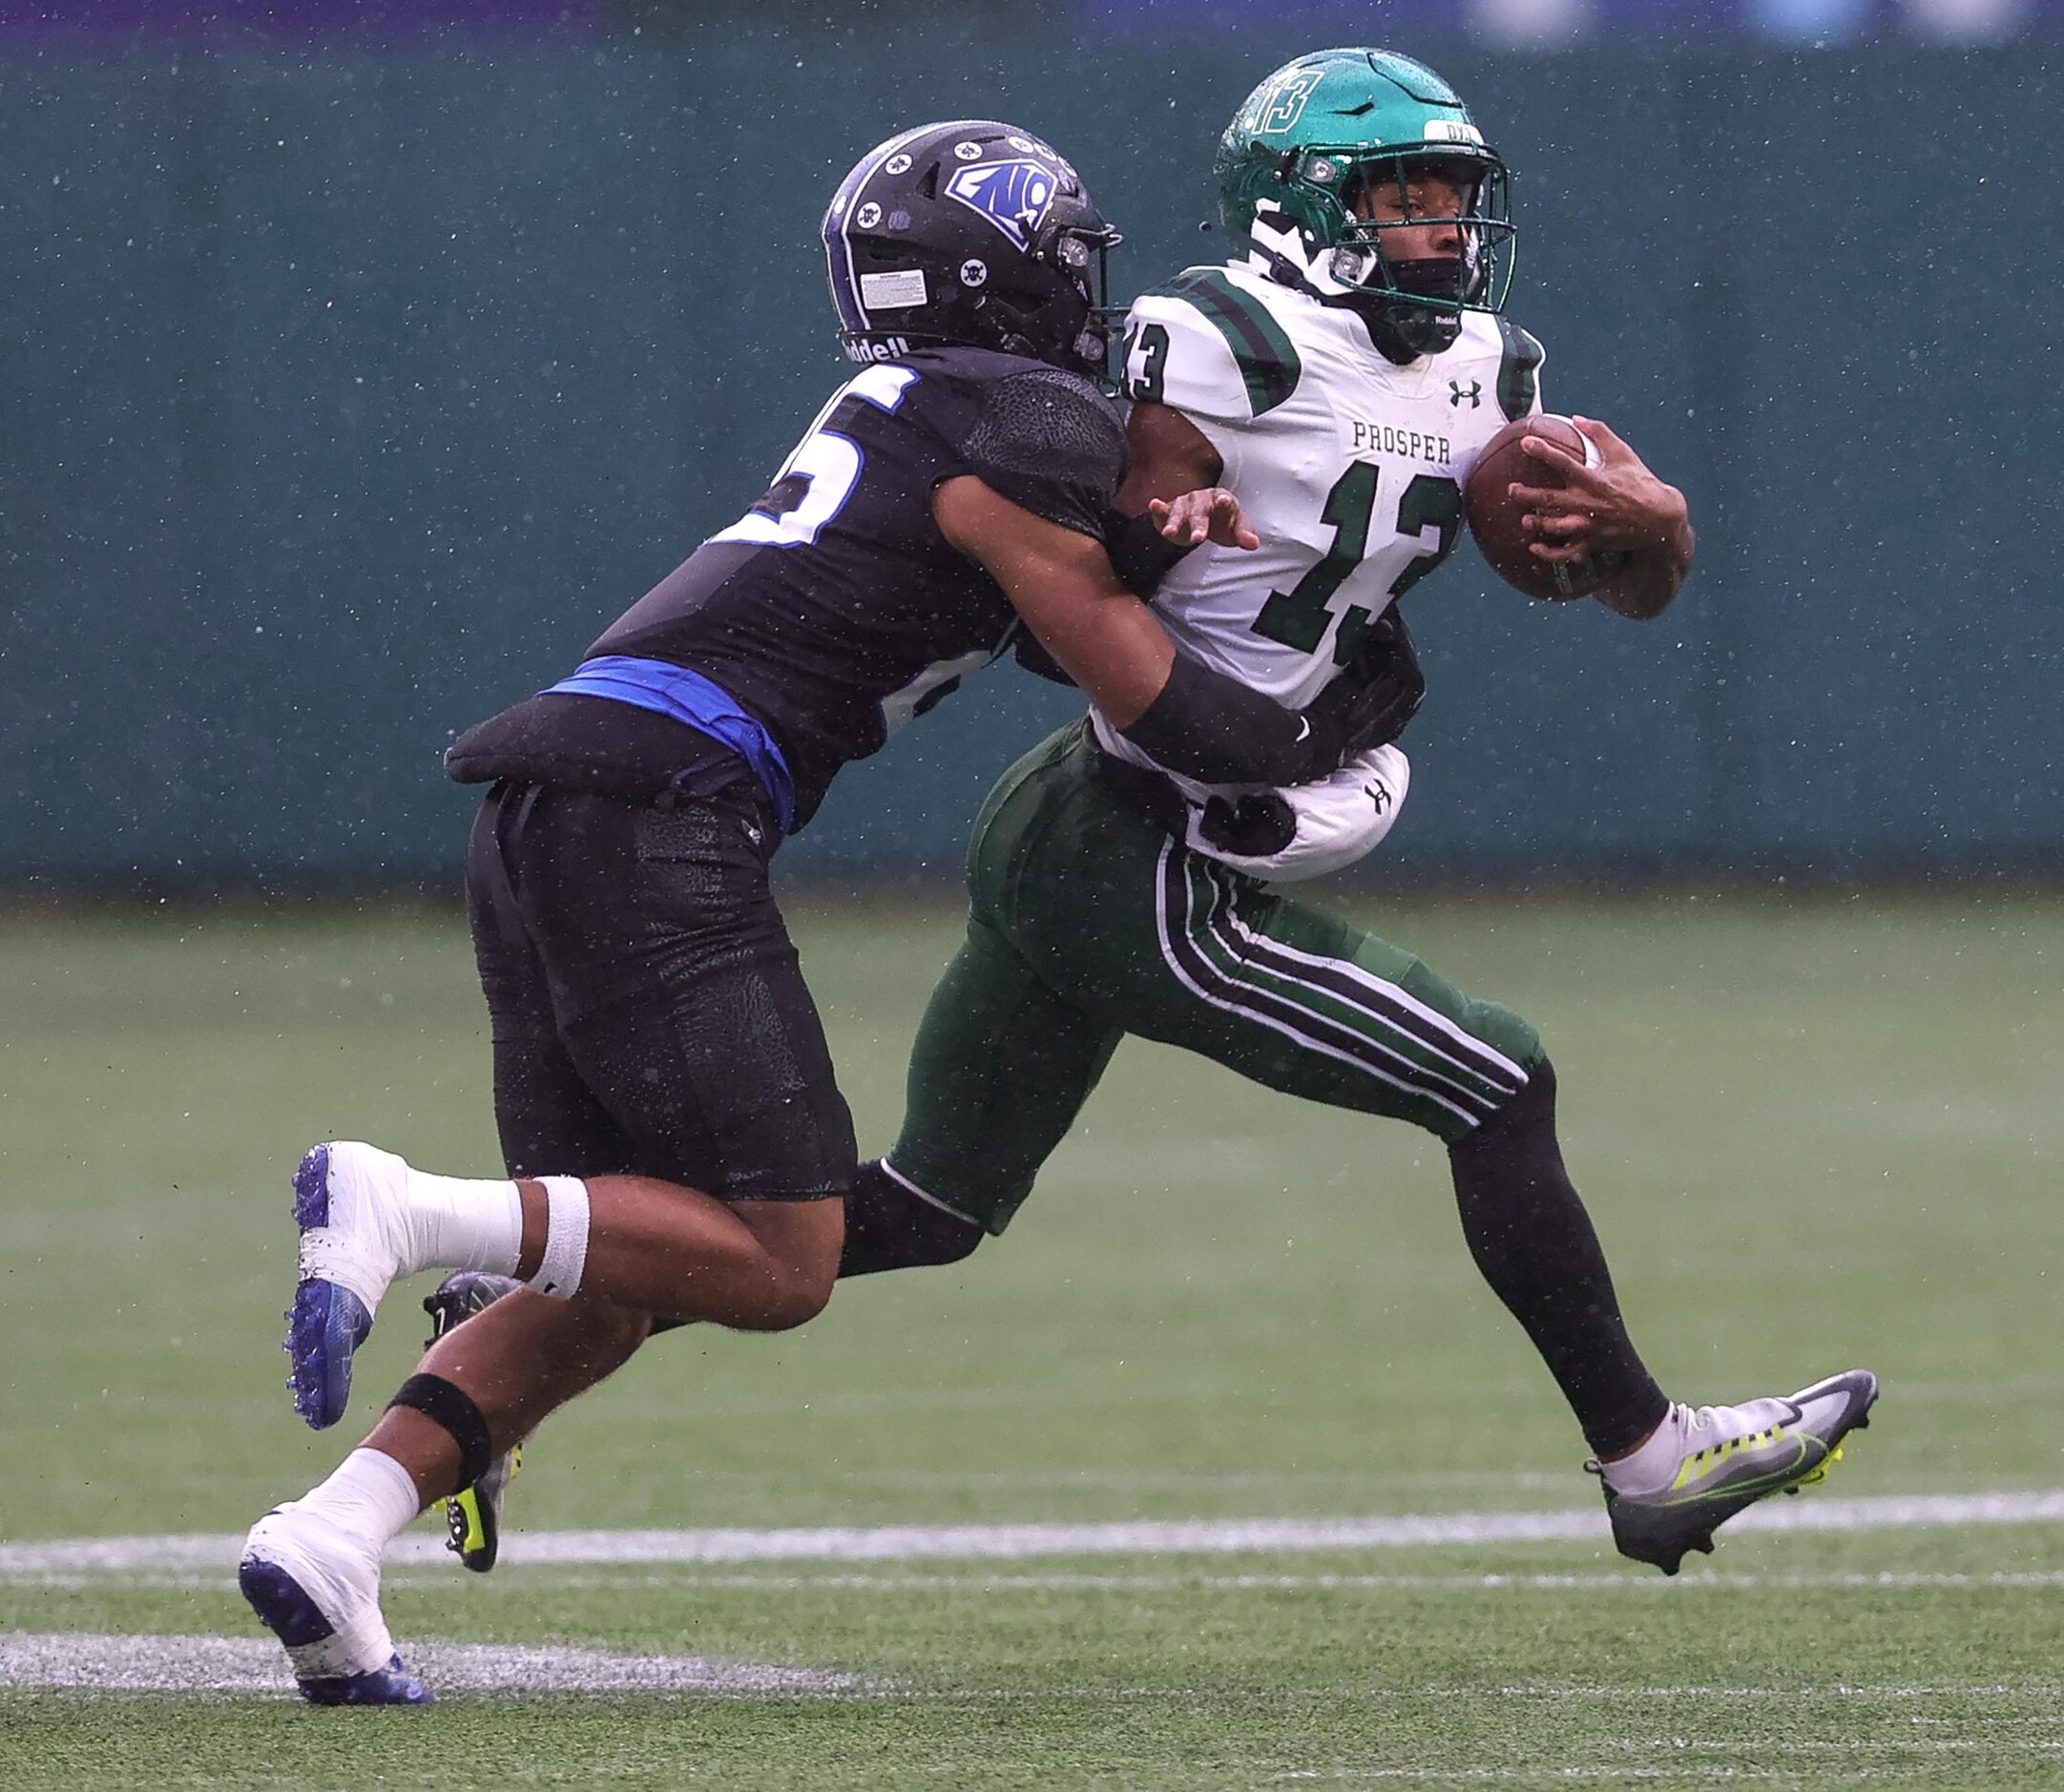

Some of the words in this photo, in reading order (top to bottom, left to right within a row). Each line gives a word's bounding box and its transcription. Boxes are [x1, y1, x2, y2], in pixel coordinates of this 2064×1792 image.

[1251, 70, 1326, 135] 13
[1352, 420, 1451, 466] PROSPER
[1250, 459, 1462, 666] 13
